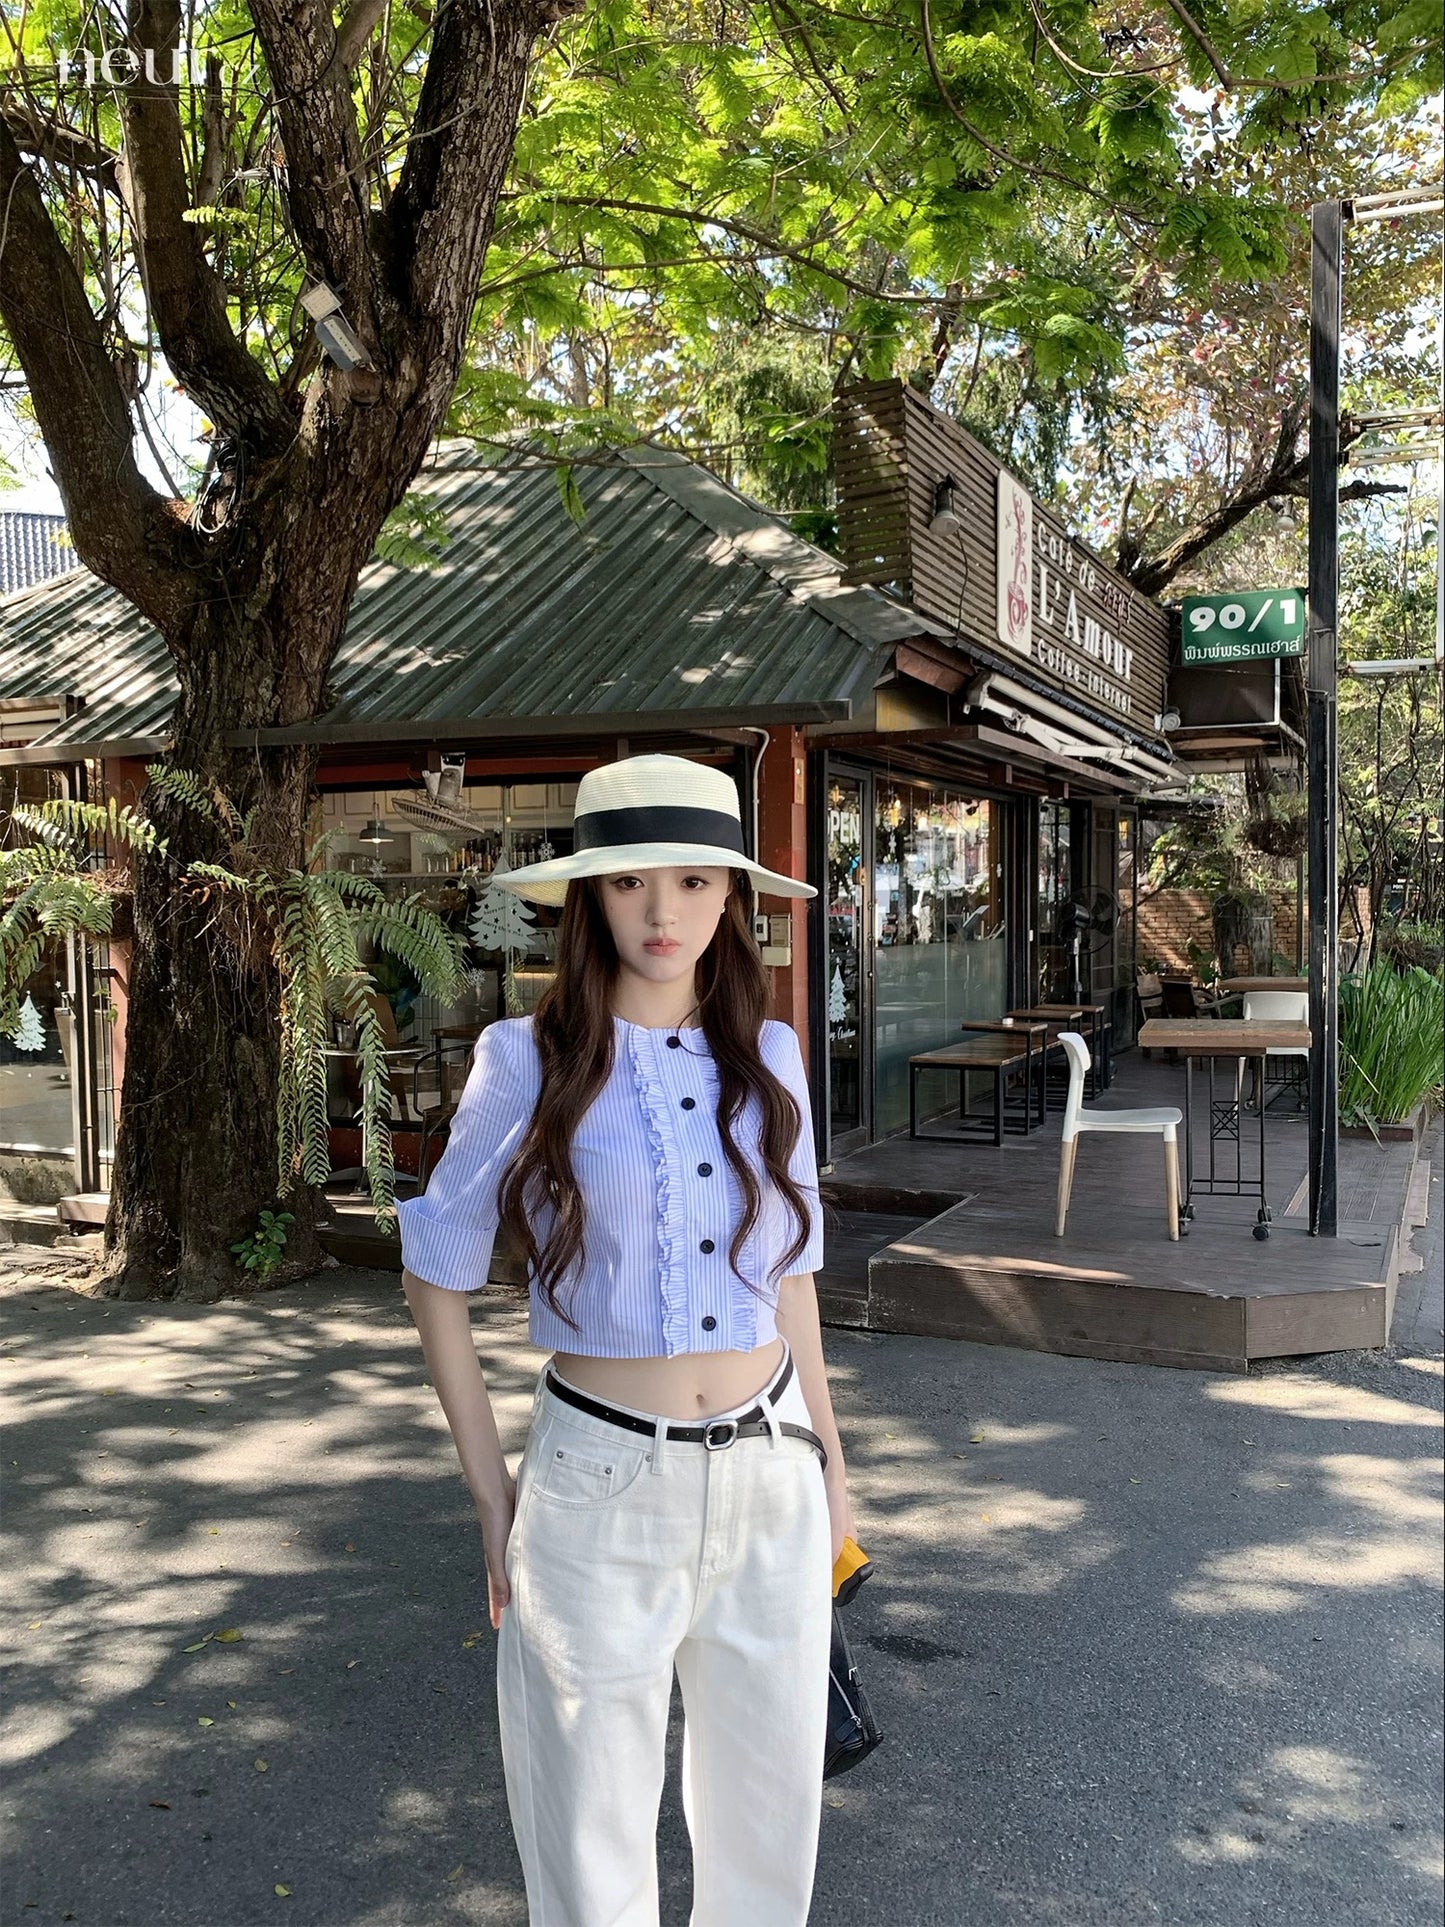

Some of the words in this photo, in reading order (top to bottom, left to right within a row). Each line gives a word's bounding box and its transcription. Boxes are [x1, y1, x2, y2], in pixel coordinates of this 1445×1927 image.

[1038, 562, 1133, 681] L'Amour
[1189, 598, 1296, 633] 90/1
[1184, 635, 1301, 661] พิมพ์พรรณเฮาส์
[827, 810, 860, 844] PEN
